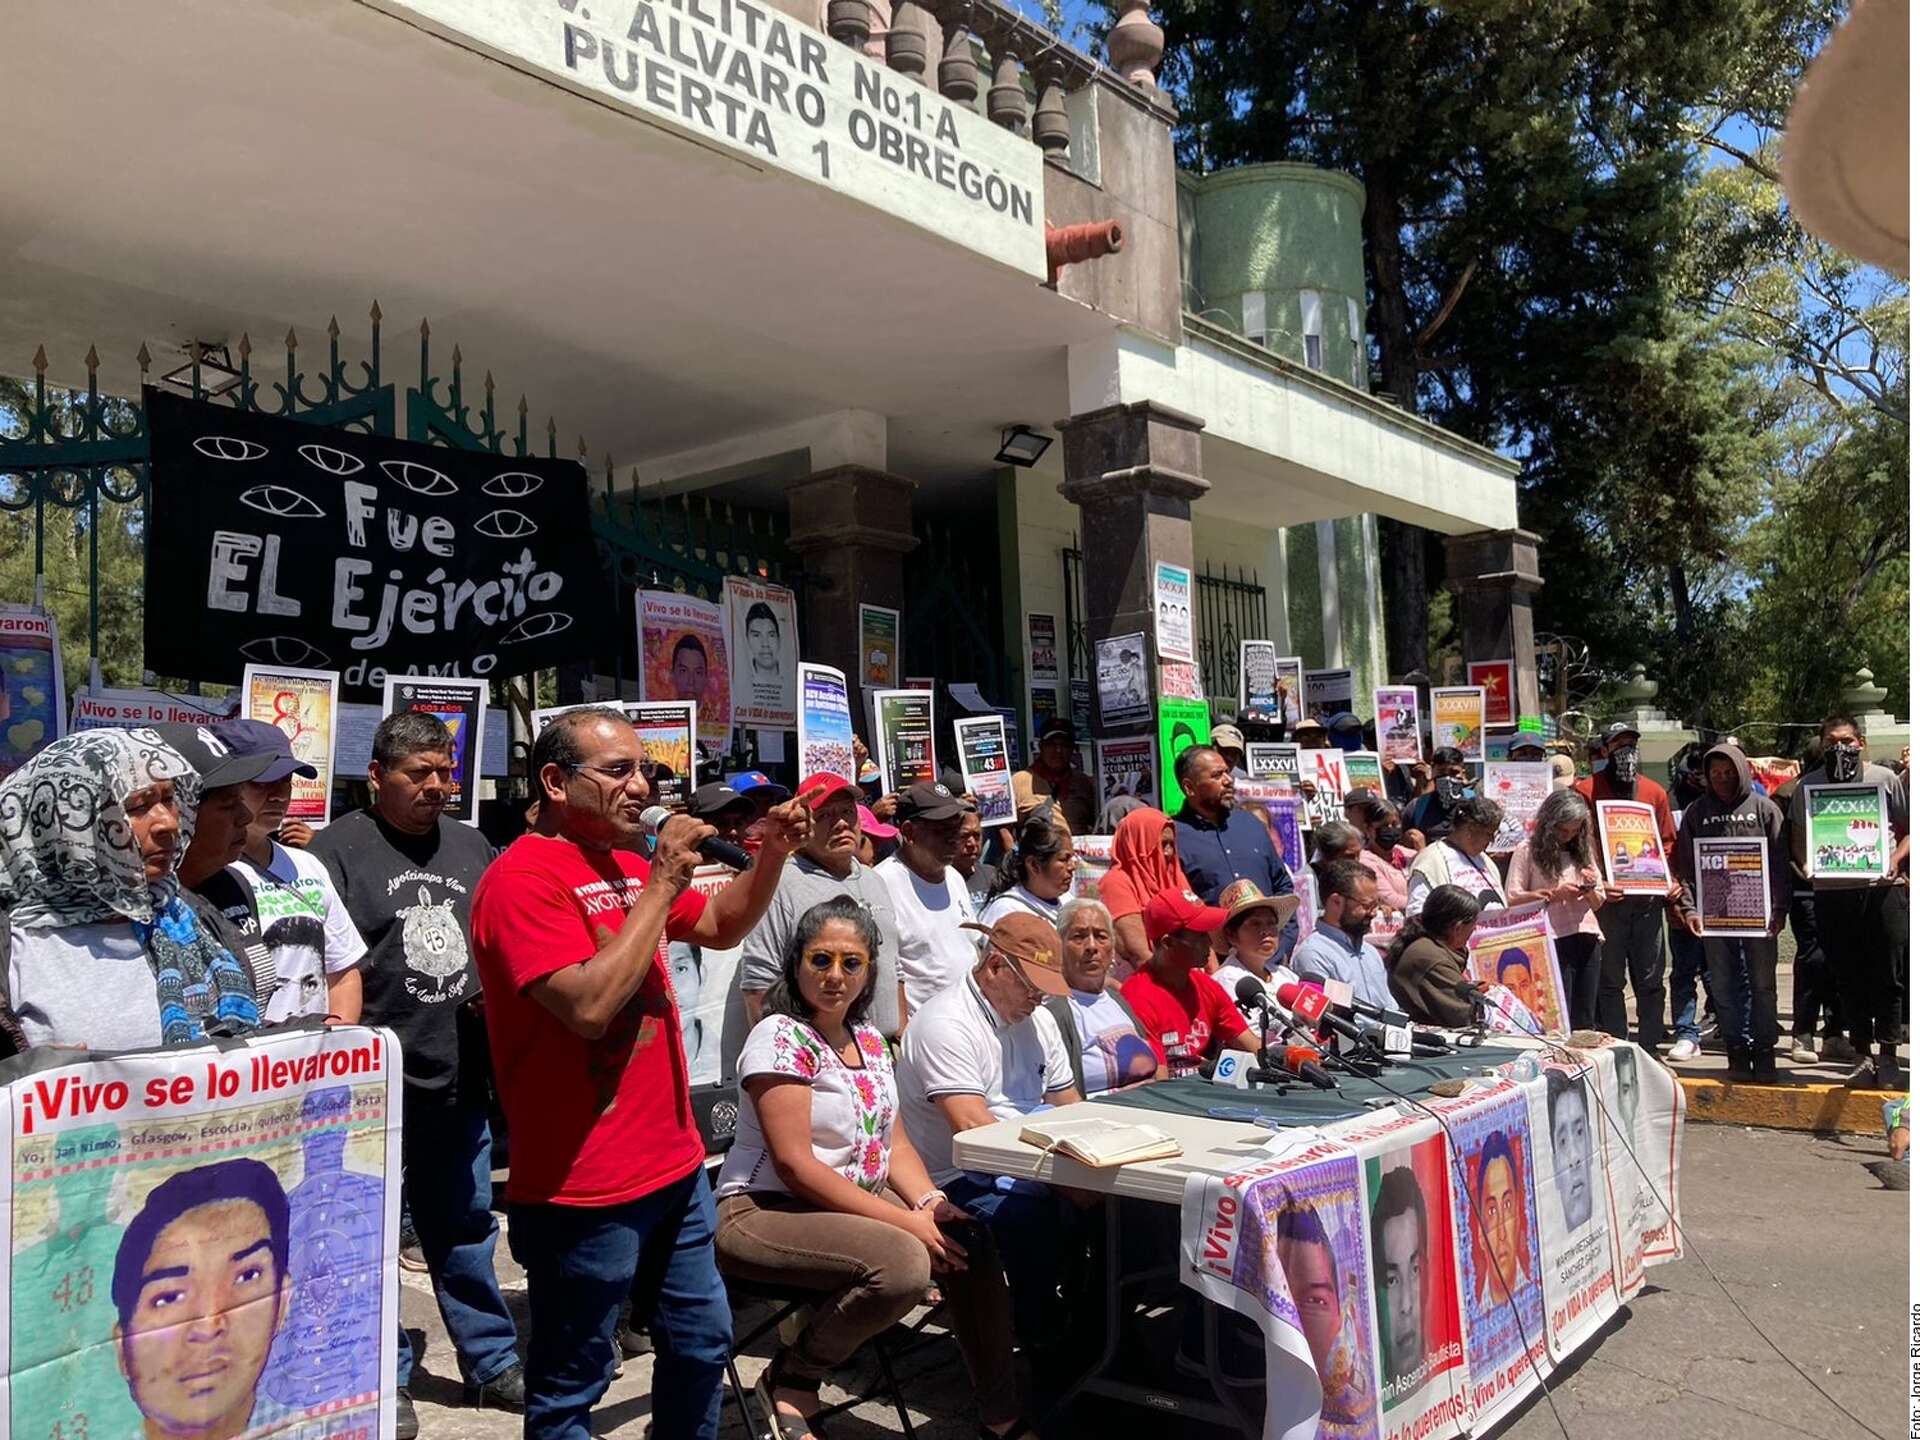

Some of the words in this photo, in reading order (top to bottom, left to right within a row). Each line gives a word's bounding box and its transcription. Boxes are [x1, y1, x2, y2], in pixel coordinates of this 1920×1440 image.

[563, 21, 778, 157] PUERTA
[812, 139, 830, 179] 1
[645, 0, 829, 84] LITAR
[854, 61, 960, 148] No.1-A
[848, 108, 1033, 226] OBREGÓN
[344, 480, 455, 556] Fue
[207, 530, 301, 617] EL
[331, 547, 564, 650] Ejército
[344, 658, 388, 689] de
[123, 706, 142, 719] se
[149, 706, 163, 721] lo
[387, 870, 443, 896] Ayotzinapa
[424, 931, 446, 952] 43
[22, 1077, 128, 1134] ¡Vivo
[144, 1076, 194, 1107] se
[207, 1062, 240, 1100] lo
[251, 1037, 381, 1092] llevaron!
[21, 1151, 46, 1166] Yo,
[131, 1128, 192, 1146] Glasgow,
[201, 1122, 252, 1138] Escocia,
[1203, 1196, 1238, 1277] ¡Vivo
